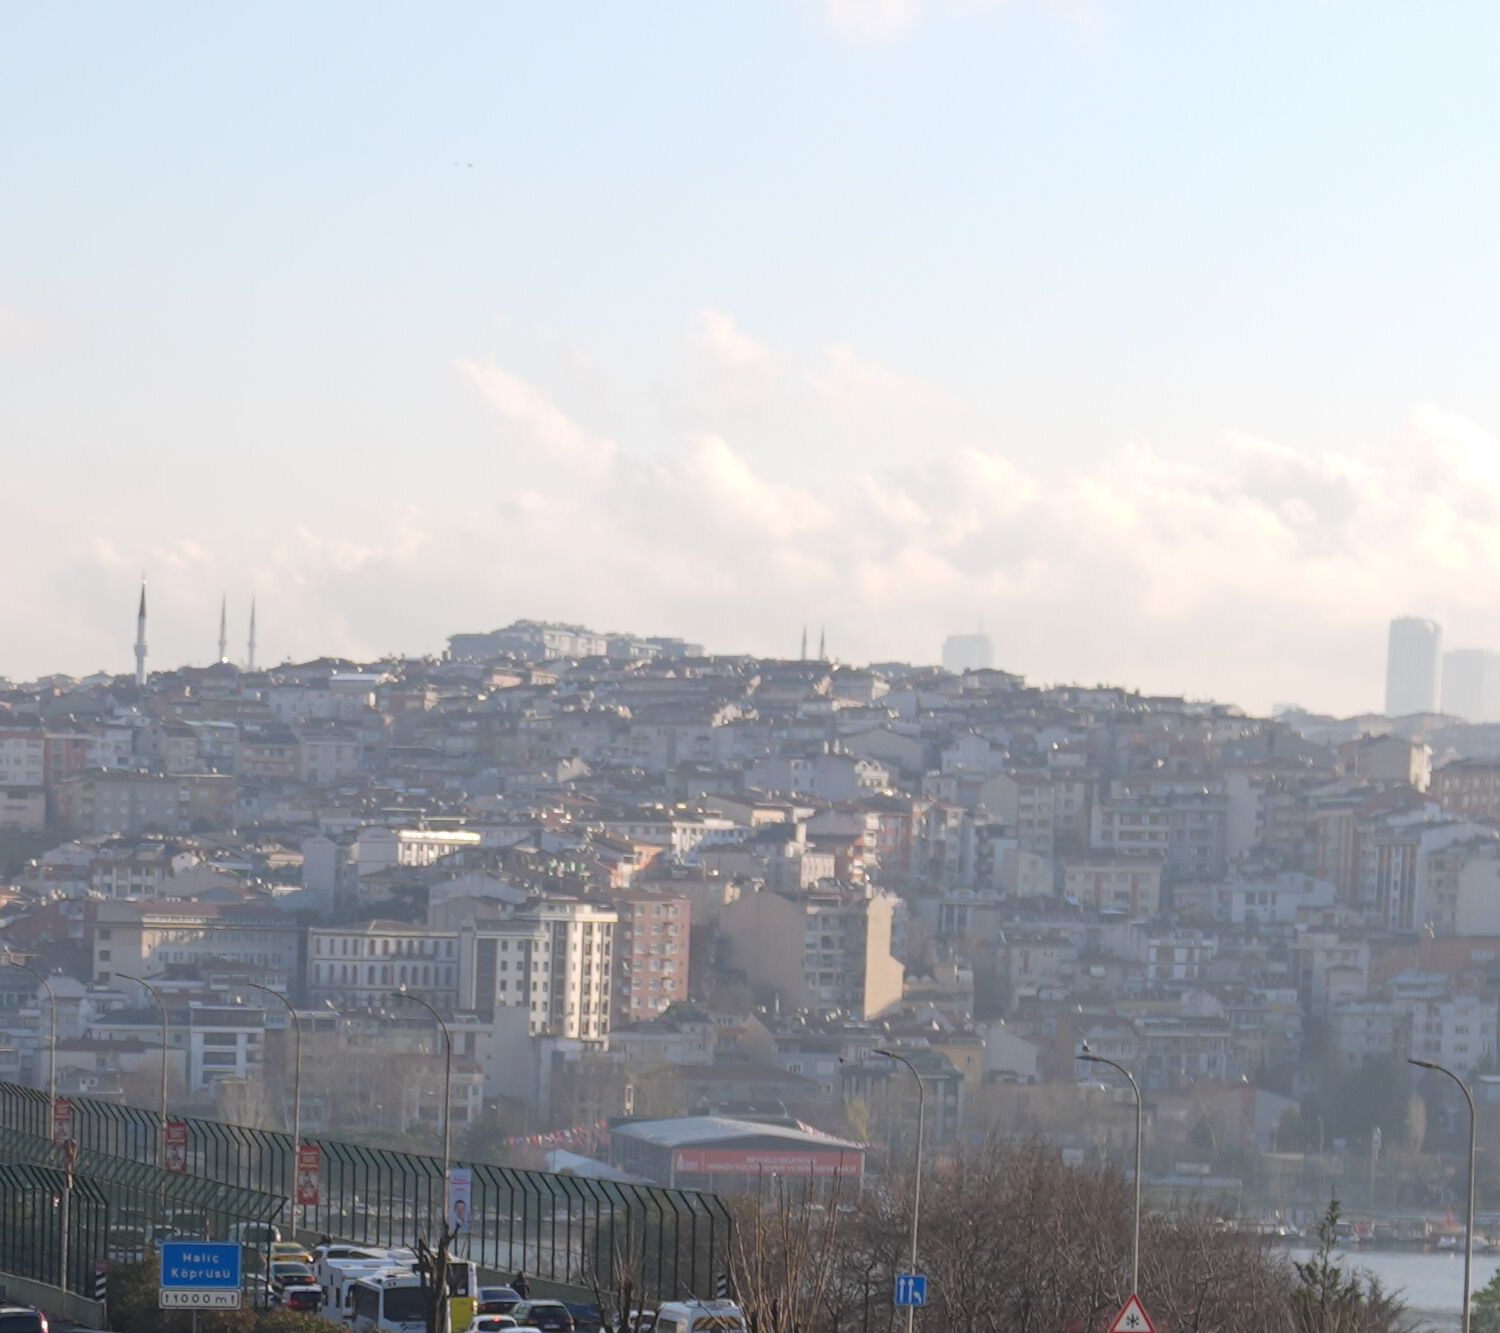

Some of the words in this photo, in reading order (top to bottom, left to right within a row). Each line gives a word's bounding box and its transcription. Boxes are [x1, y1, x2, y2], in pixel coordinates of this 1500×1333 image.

[182, 1253, 219, 1265] Haliç
[170, 1267, 231, 1282] Köprüsü
[173, 1294, 211, 1305] 1000
[215, 1296, 227, 1304] m
